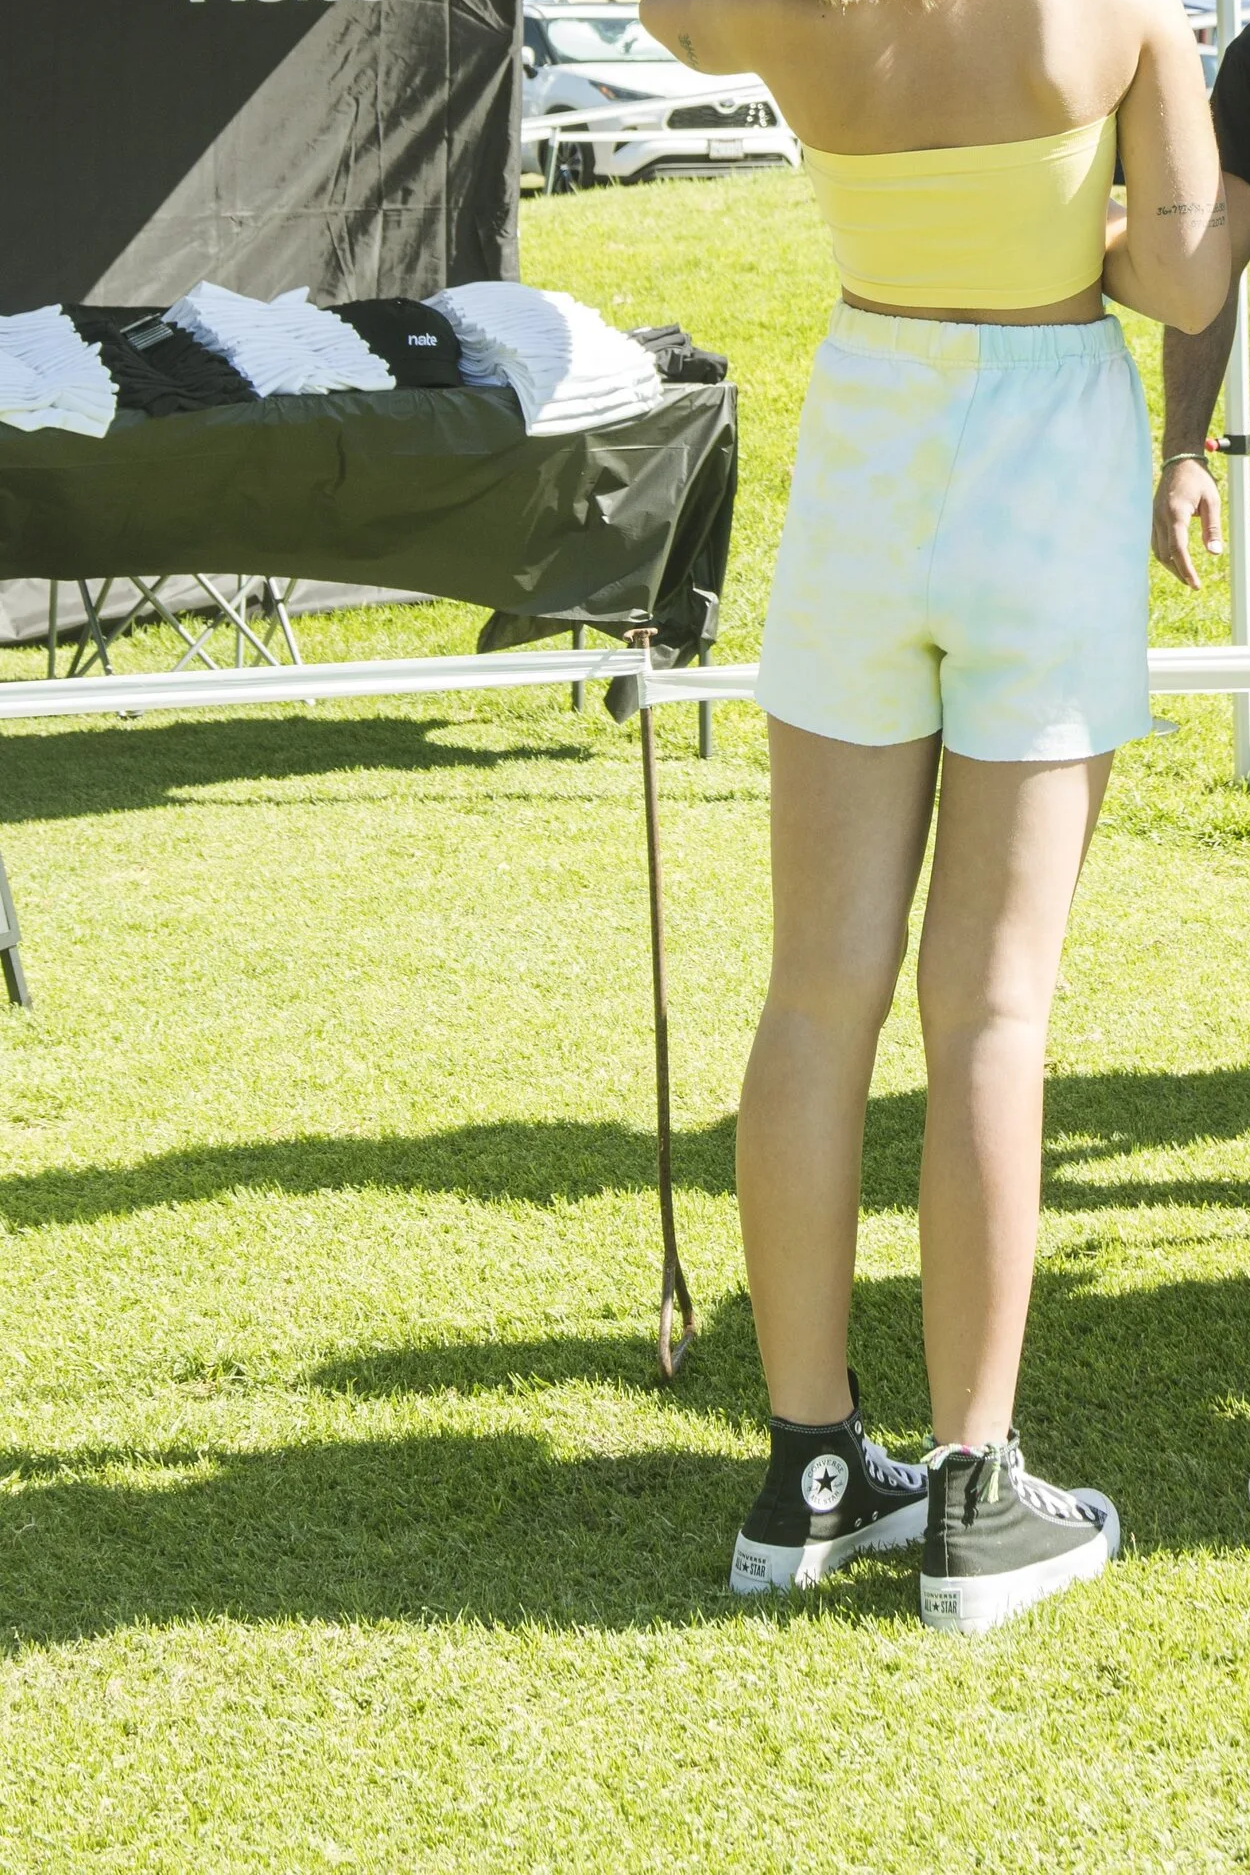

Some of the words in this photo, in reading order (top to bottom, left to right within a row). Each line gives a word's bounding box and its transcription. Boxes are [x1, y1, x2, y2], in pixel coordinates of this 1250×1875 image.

[408, 332, 438, 346] nate
[808, 1459, 844, 1478] CONVERSE
[823, 1491, 840, 1504] STAR
[750, 1563, 766, 1577] STAR
[941, 1600, 958, 1614] STAR
